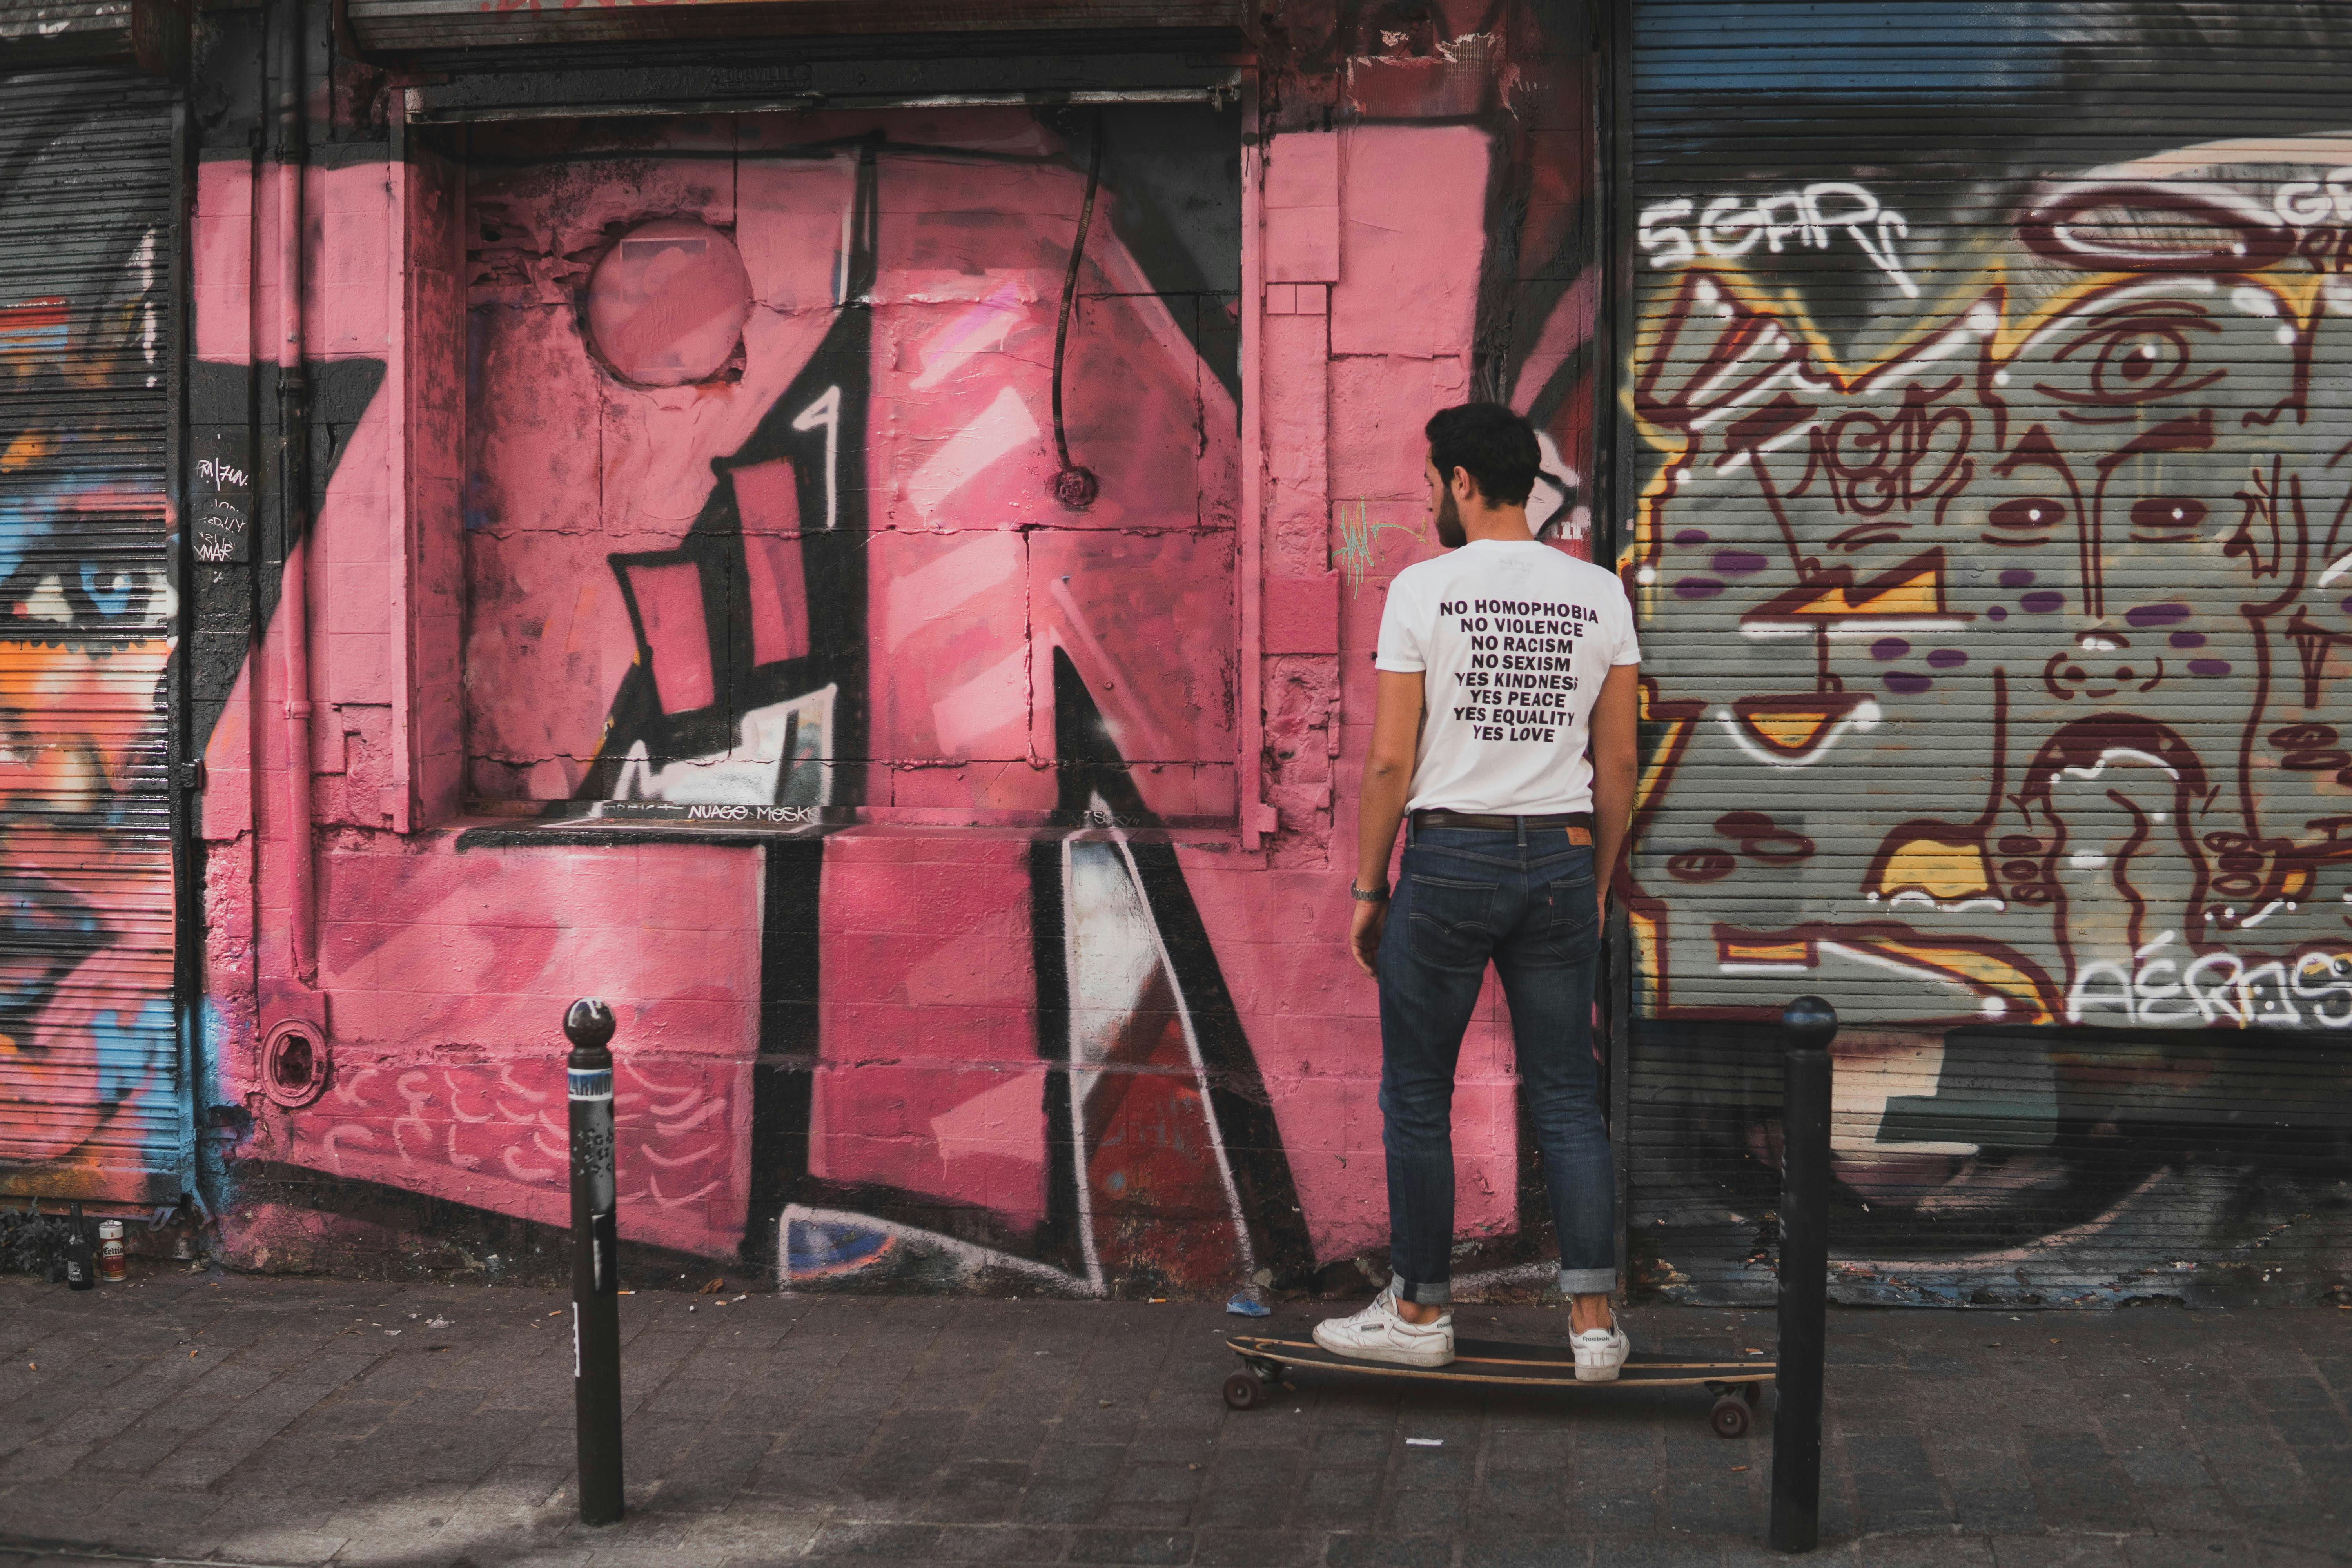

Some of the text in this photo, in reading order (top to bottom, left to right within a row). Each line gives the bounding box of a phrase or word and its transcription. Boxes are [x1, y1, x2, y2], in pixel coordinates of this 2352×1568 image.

[1440, 599, 1599, 624] NO HOMOPHOBIA
[1461, 617, 1583, 637] NO VIOLENCE
[1471, 635, 1573, 654] NO RACISM
[1472, 654, 1570, 672] NO SEXISM
[1454, 672, 1489, 686] YES
[1470, 690, 1566, 708] YES PEACE
[1454, 706, 1575, 726] YES EQUALITY
[1473, 724, 1555, 742] YES LOVE
